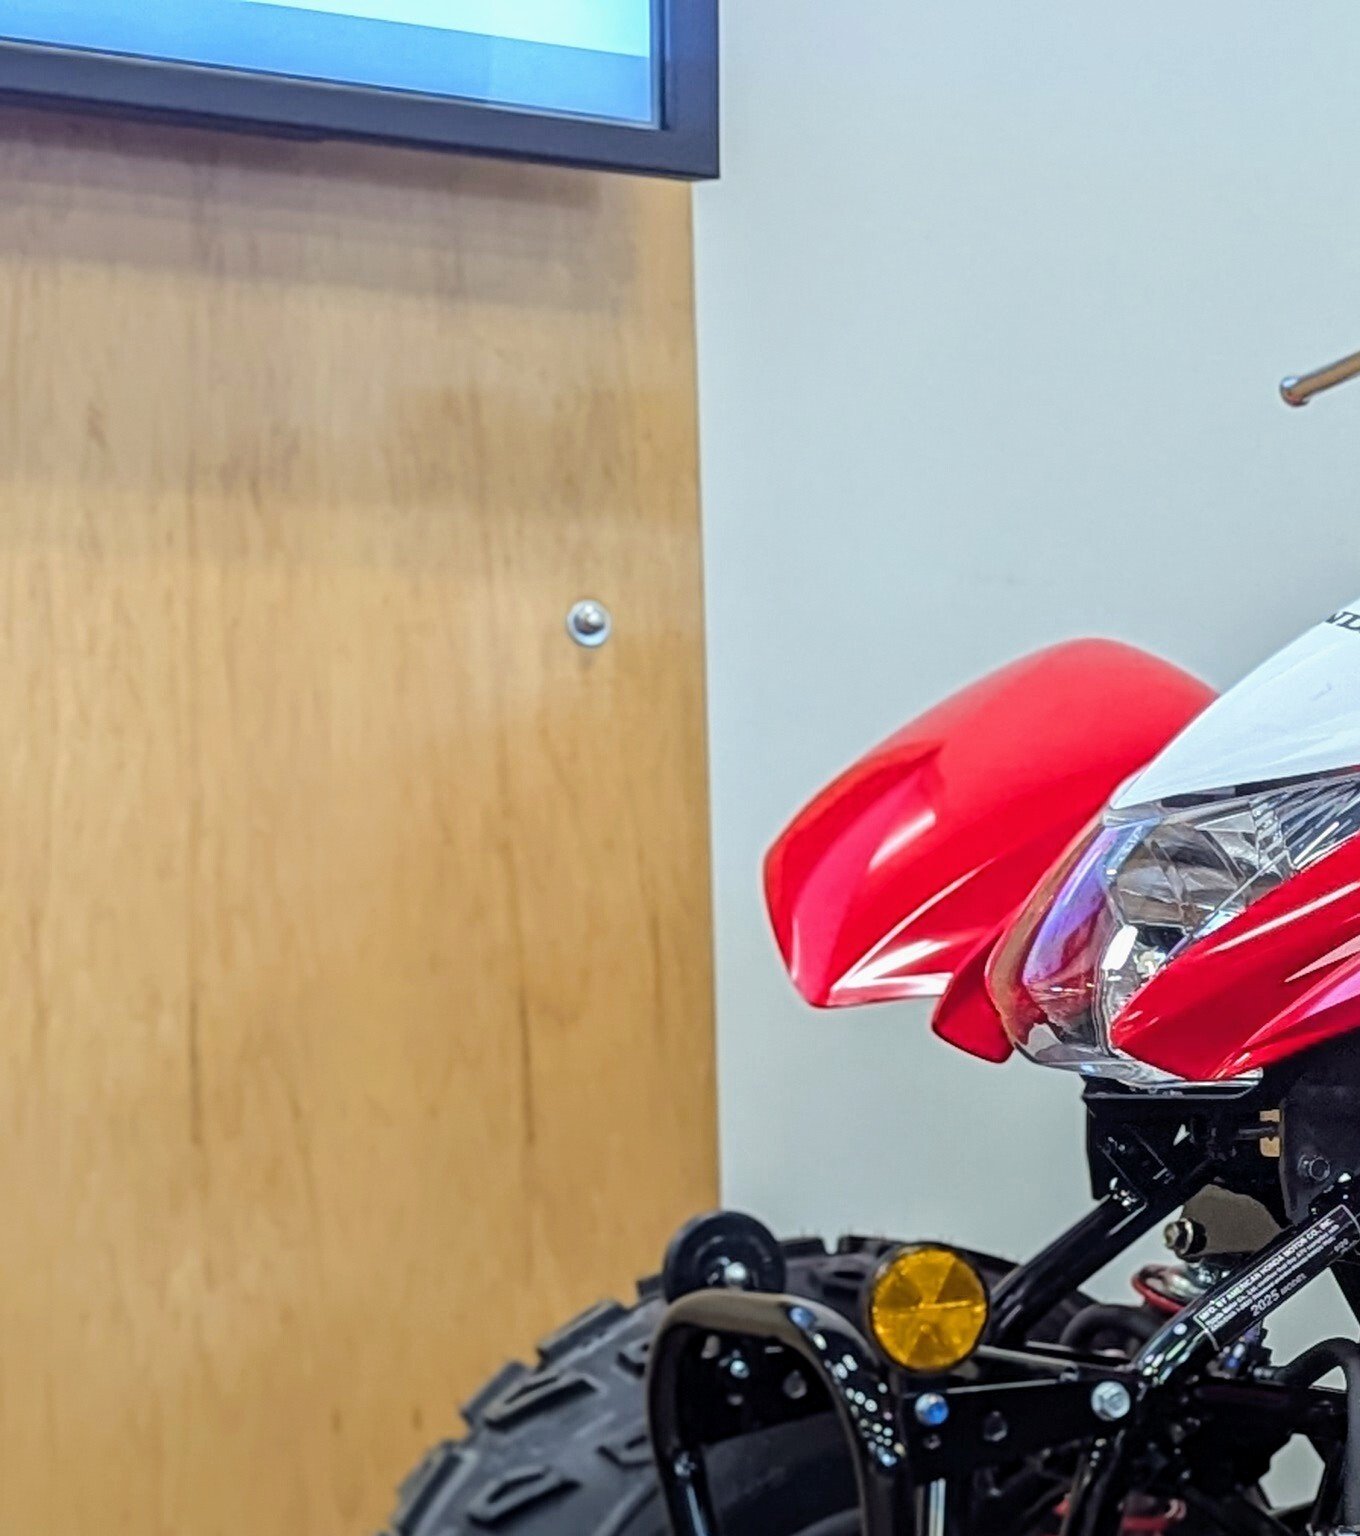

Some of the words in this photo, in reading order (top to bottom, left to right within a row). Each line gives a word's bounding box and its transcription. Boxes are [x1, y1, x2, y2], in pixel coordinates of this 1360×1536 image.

[1225, 1271, 1261, 1300] AMERICAN
[1259, 1254, 1284, 1275] HONDA
[1283, 1236, 1308, 1257] MOTOR
[1248, 1288, 1281, 1316] 2025
